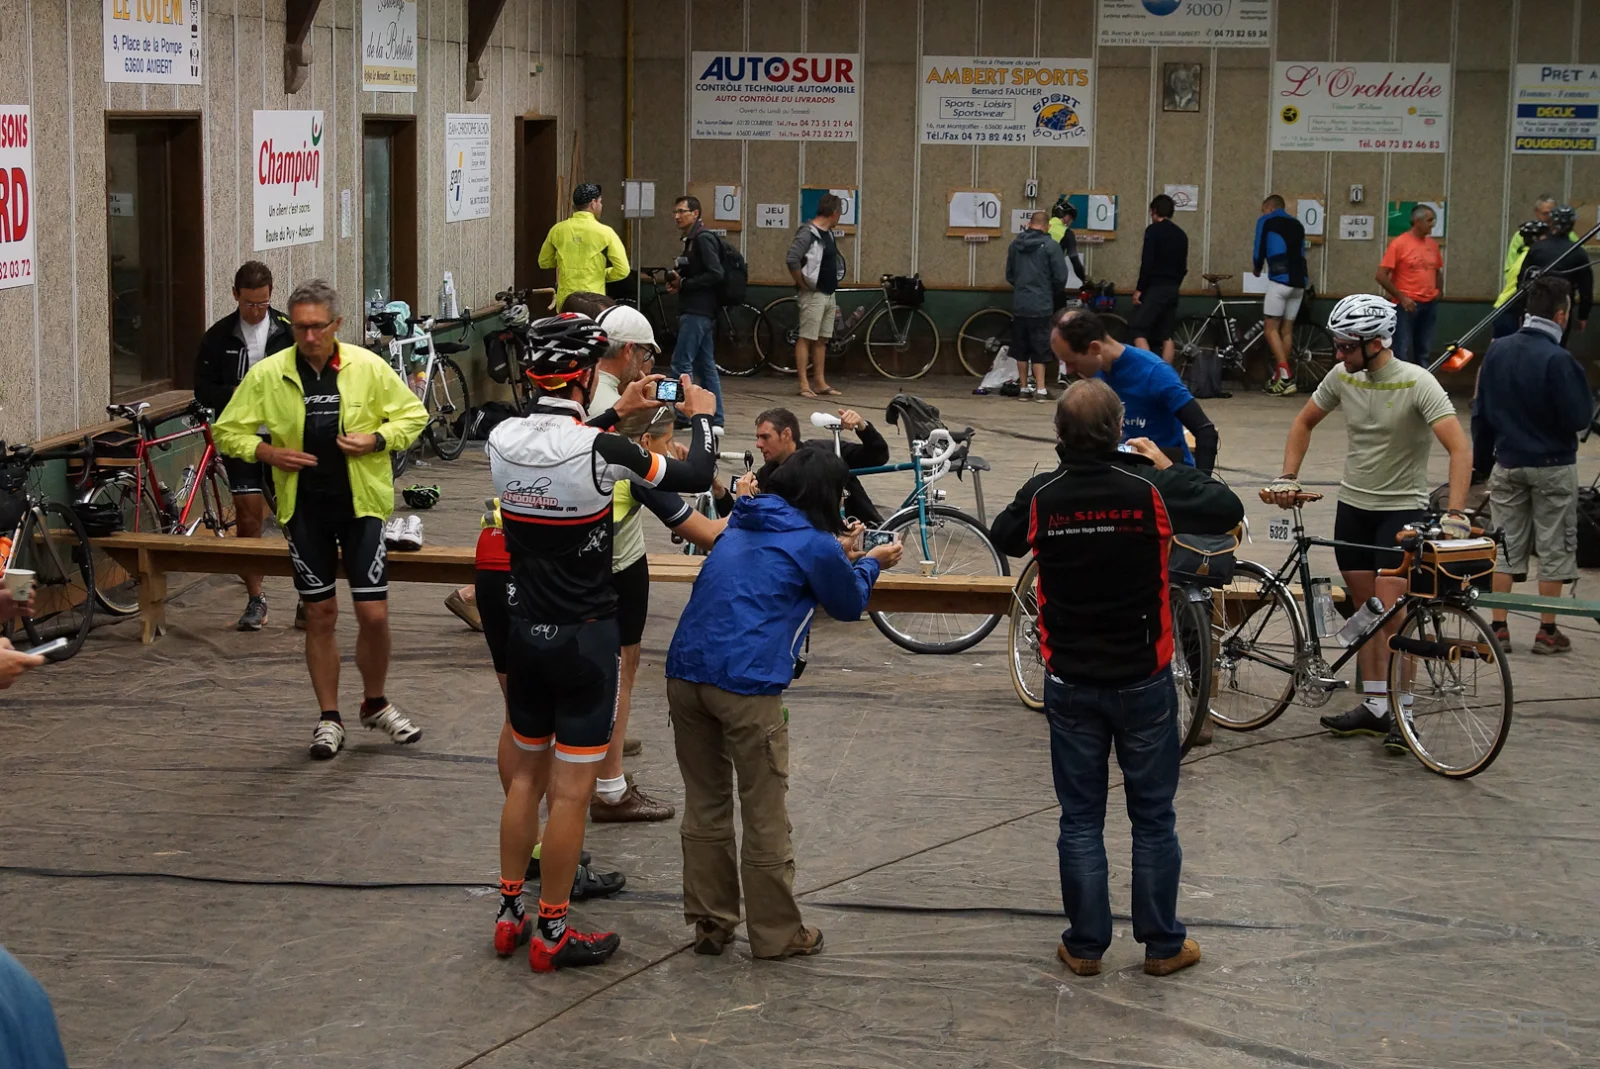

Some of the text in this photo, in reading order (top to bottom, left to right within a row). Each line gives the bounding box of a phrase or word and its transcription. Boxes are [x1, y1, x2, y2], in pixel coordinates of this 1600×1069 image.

[1185, 3, 1223, 16] 3000
[113, 34, 182, 56] 9, Place de la Pompe
[124, 57, 172, 74] 63600 AMBERT
[699, 56, 854, 83] AUTOSUR
[925, 66, 1089, 86] AMBERT SPORTS
[1280, 65, 1443, 98] L'Orchidée
[695, 82, 856, 94] CONTRÔLE TECHNIQUE AUTOMOBILE
[972, 87, 1042, 96] Bernard FAUCHER
[715, 93, 836, 104] AUTO CONTRÔLE DU LIVRADOIS
[945, 99, 1012, 109] Sports Loisirs
[1032, 93, 1081, 113] SPORT
[953, 108, 1006, 118] Sportswear
[0, 113, 28, 149] SONS
[812, 130, 821, 138] 73
[926, 131, 1026, 142] Tél./Fax 04 73 82 42 51
[1358, 139, 1440, 149] Tél. 04 73 82 46 83
[258, 138, 320, 197] Champion
[449, 169, 462, 192] gan
[269, 204, 277, 218] Un
[277, 202, 288, 217] client
[722, 193, 735, 212] 0
[765, 206, 784, 215] JEU
[977, 200, 998, 219] 10
[1019, 211, 1032, 220] JE
[1096, 203, 1109, 222] 0
[1305, 207, 1317, 226] 0
[1347, 218, 1368, 226] JEU
[266, 222, 314, 243] Route du Puy Ambert
[1362, 230, 1368, 238] 3
[9, 260, 20, 280] 03
[21, 258, 31, 277] 72
[506, 476, 552, 495] Cycles
[1065, 527, 1081, 535] Victor
[1082, 526, 1096, 534] Hugo
[1269, 525, 1288, 540] 5328
